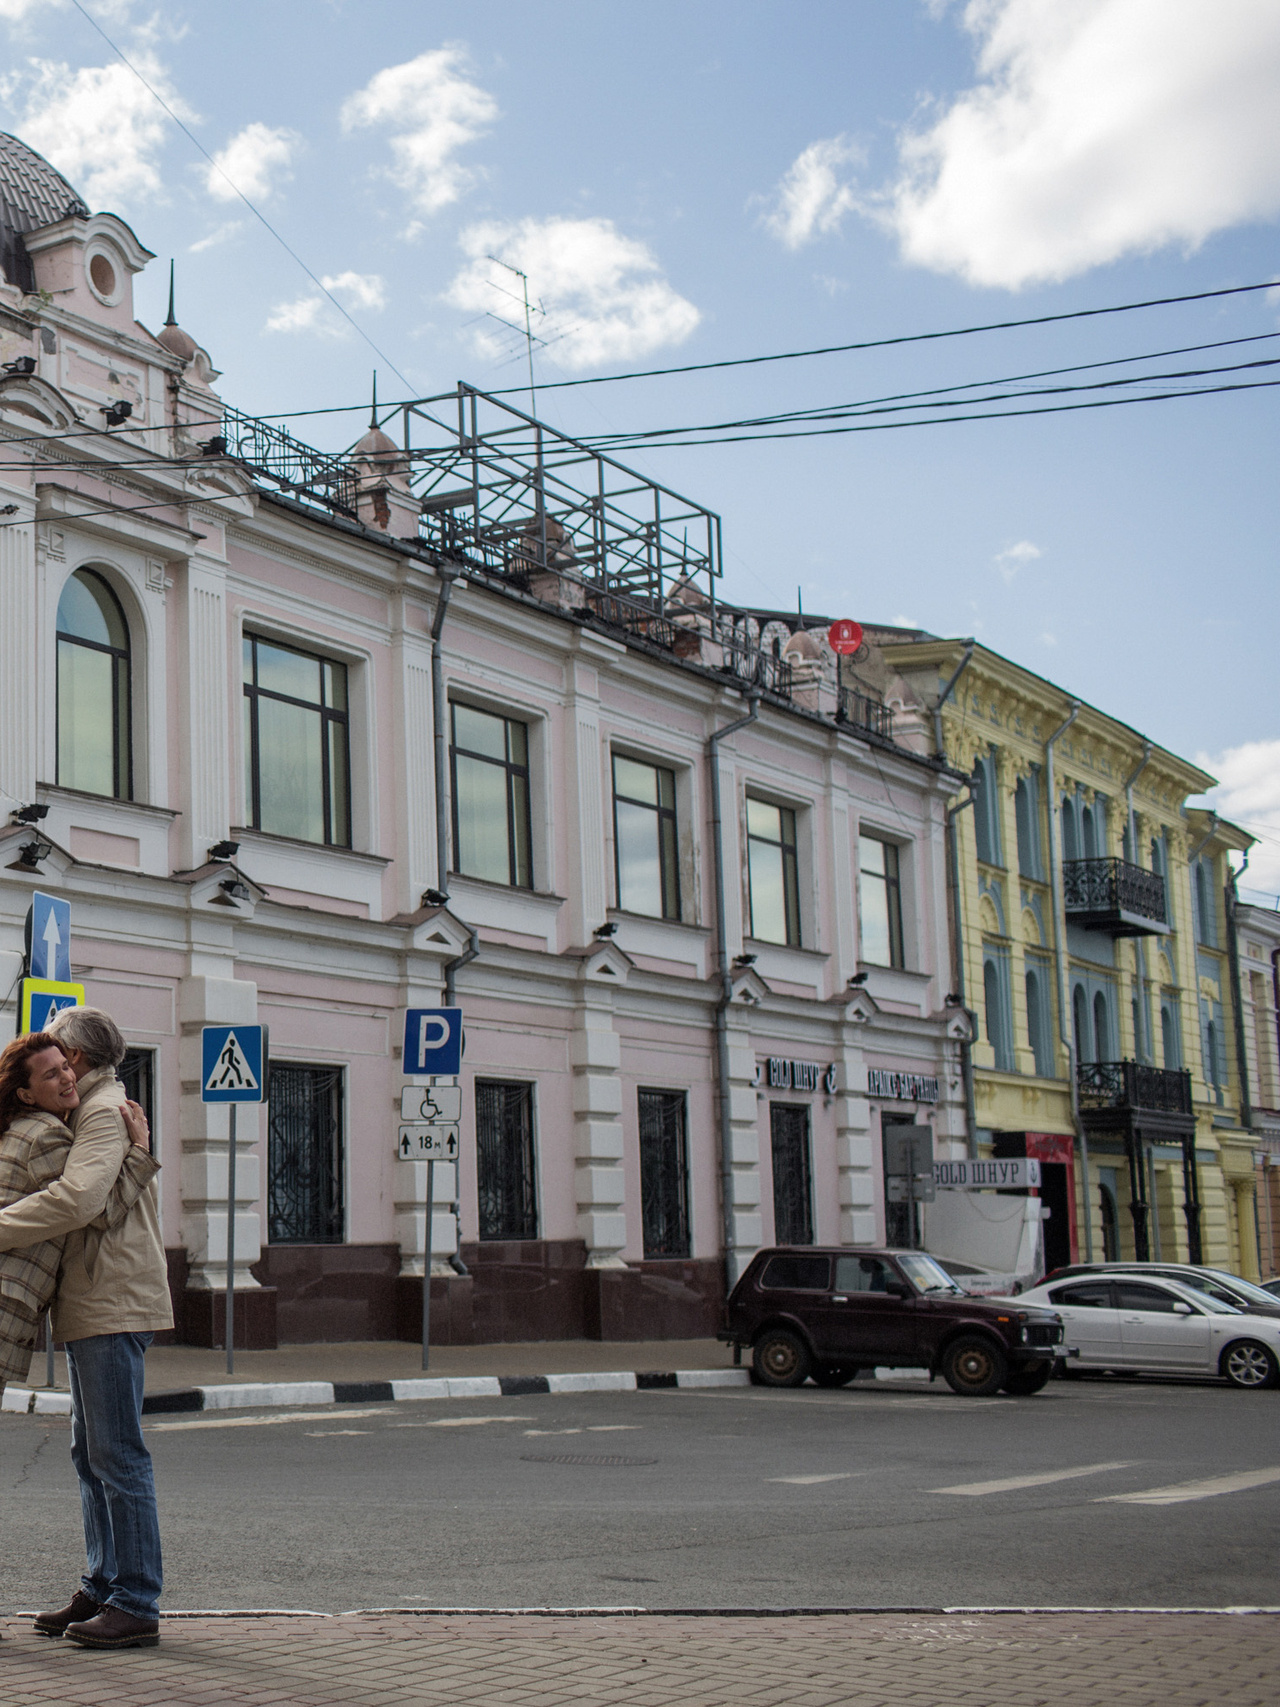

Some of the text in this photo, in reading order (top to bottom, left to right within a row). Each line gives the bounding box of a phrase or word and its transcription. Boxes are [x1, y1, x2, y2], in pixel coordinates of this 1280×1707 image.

[417, 1014, 451, 1068] P
[769, 1057, 820, 1091] GOLD ШНУР
[866, 1069, 897, 1098] АРАОКЕ
[418, 1135, 433, 1150] 18
[931, 1162, 1019, 1185] GOLD ШНУР
